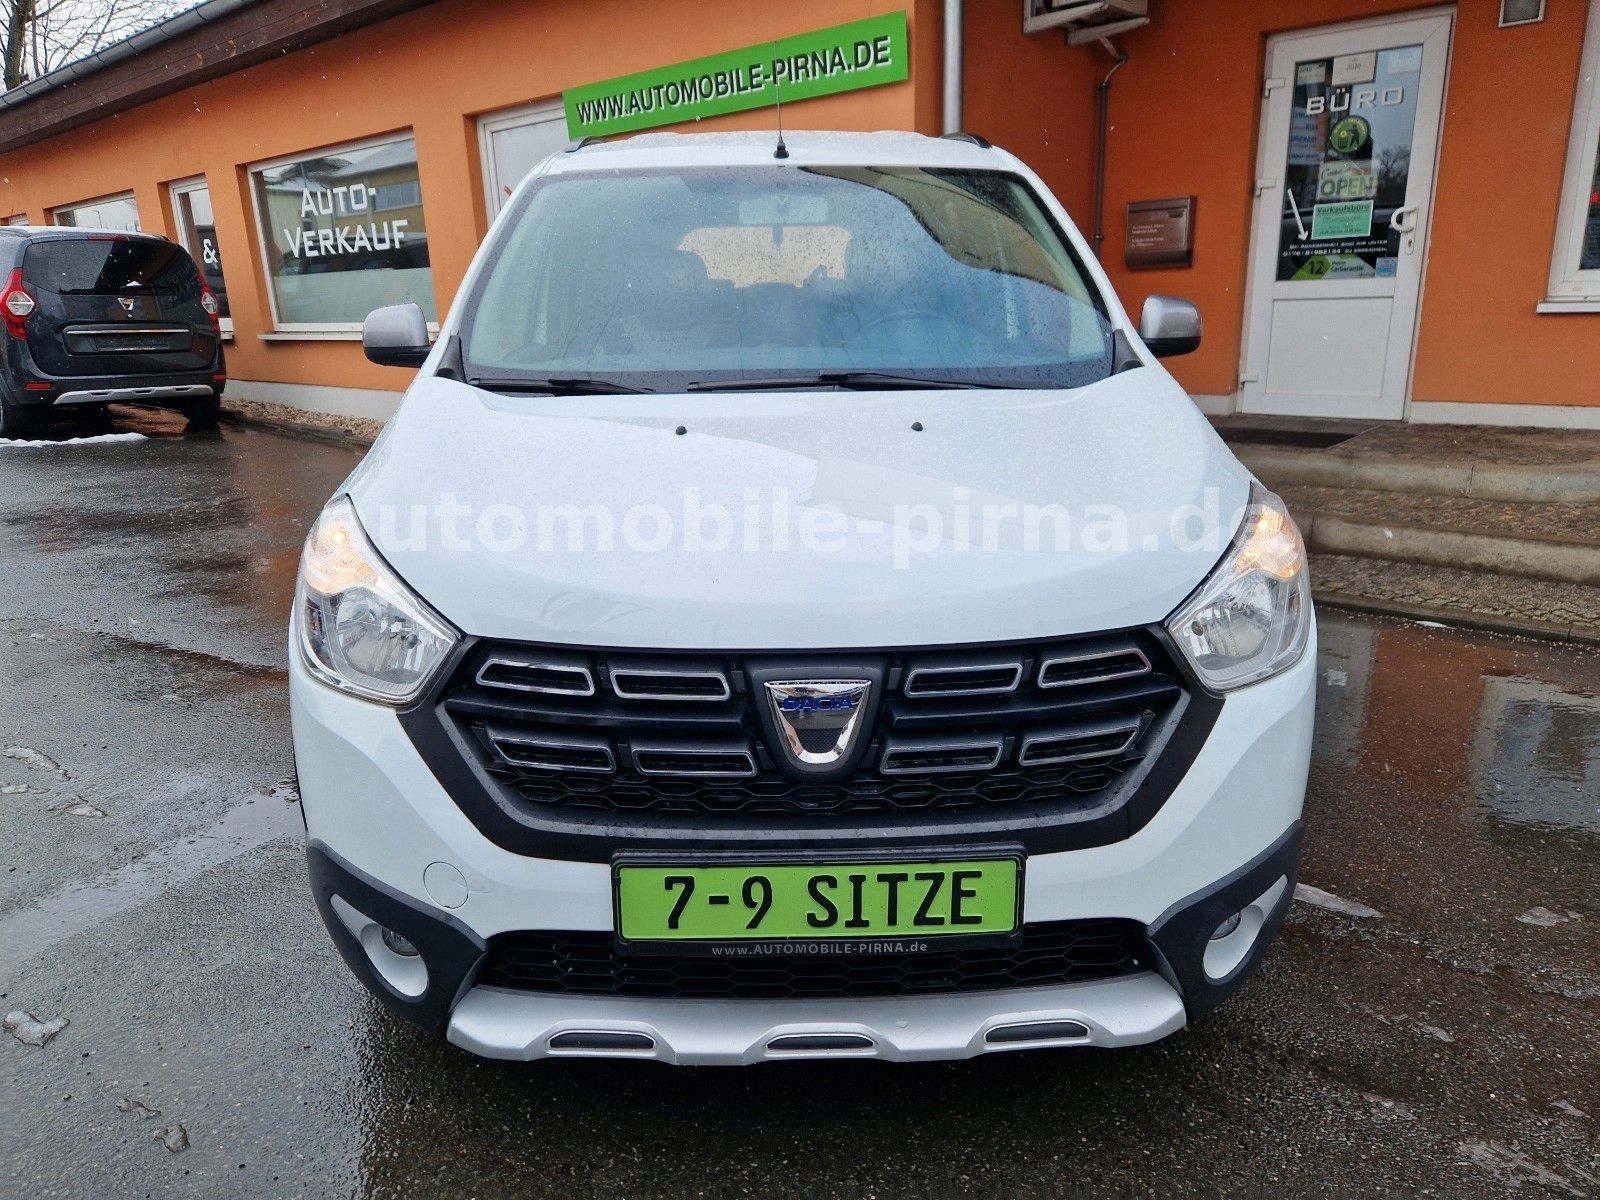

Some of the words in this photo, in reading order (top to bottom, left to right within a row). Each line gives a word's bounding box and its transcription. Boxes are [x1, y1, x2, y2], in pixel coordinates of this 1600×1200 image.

[576, 35, 892, 125] WWW.AUTOMOBILE-PIRNA.DE
[1306, 86, 1404, 115] BÜRO
[1320, 175, 1374, 197] OPEN
[300, 183, 376, 218] AUTO-
[203, 238, 219, 264] &
[284, 219, 409, 258] VERKAUF
[1308, 260, 1324, 275] 12
[783, 695, 854, 712] DACIA
[806, 870, 983, 928] SITZE
[711, 940, 928, 957] www.AUTOMOBILE-PIRNA.de
